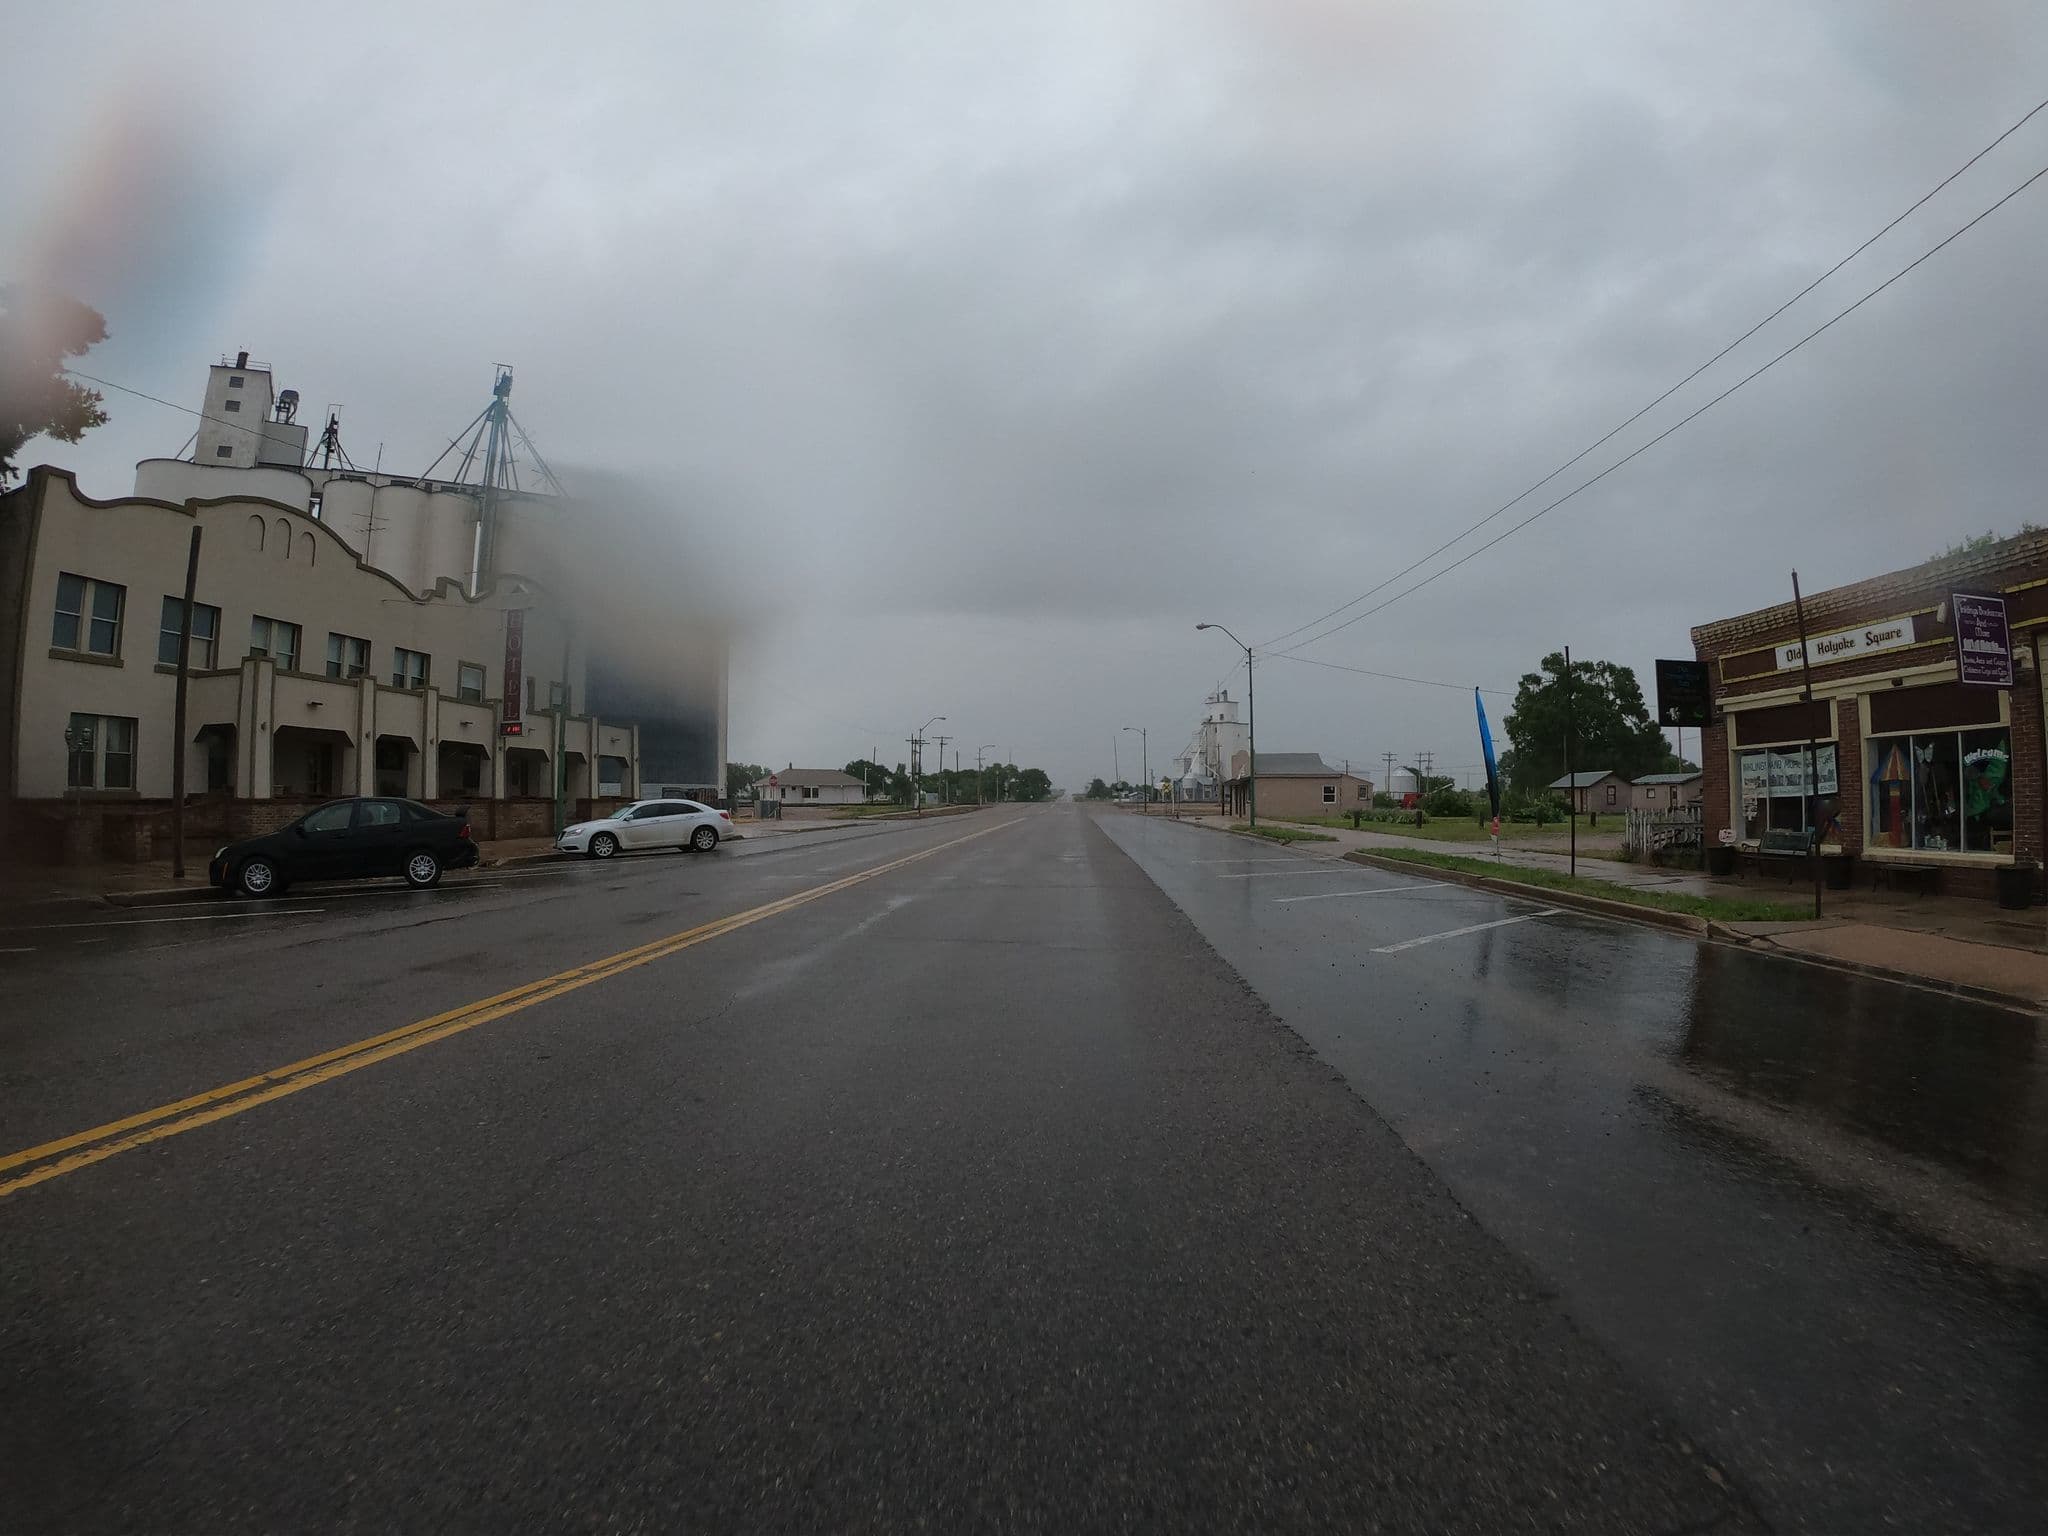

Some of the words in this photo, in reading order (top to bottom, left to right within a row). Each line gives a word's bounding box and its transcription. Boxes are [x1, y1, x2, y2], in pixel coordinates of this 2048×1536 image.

[504, 611, 520, 718] HOTEL
[1786, 648, 1805, 662] Old
[1817, 638, 1855, 655] Holyoke
[1866, 628, 1902, 646] Square
